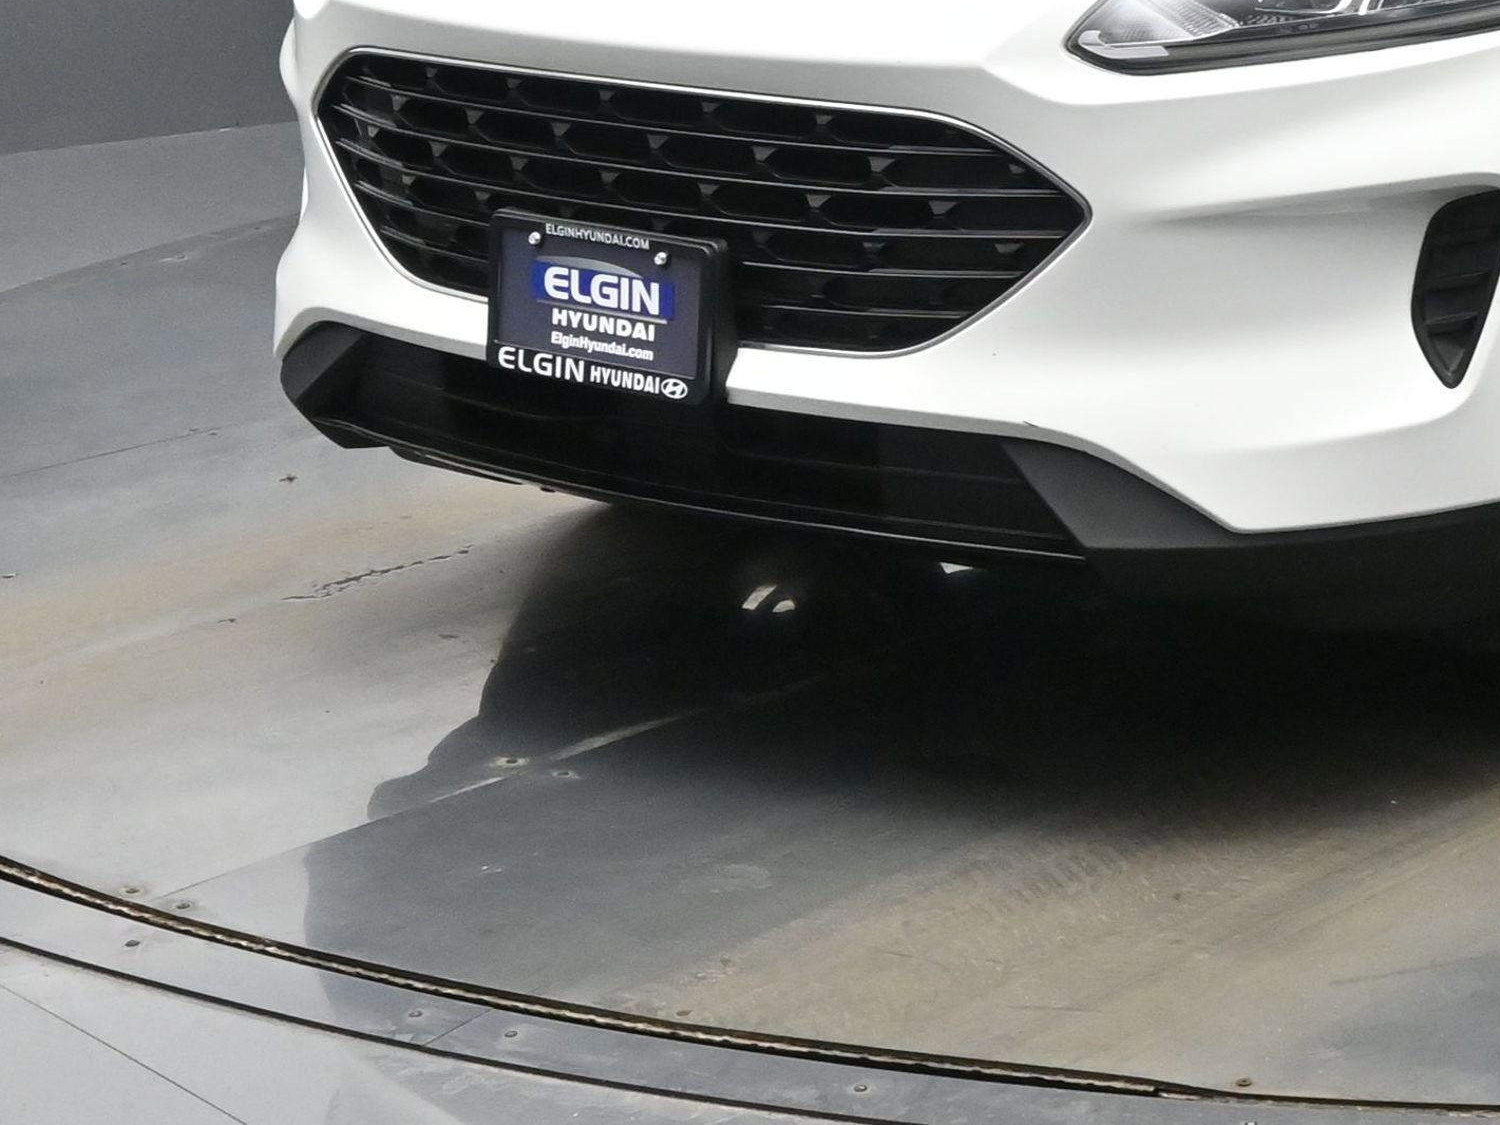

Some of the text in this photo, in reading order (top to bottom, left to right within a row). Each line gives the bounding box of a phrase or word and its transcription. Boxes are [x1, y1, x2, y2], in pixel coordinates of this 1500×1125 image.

[545, 223, 650, 250] ELGINHYUNDAI.COM
[543, 266, 660, 315] ELGIN
[551, 308, 655, 342] HYUNDAI
[550, 331, 654, 361] ElginHyundai.com
[498, 346, 660, 394] ELGIN HYUNDAI
